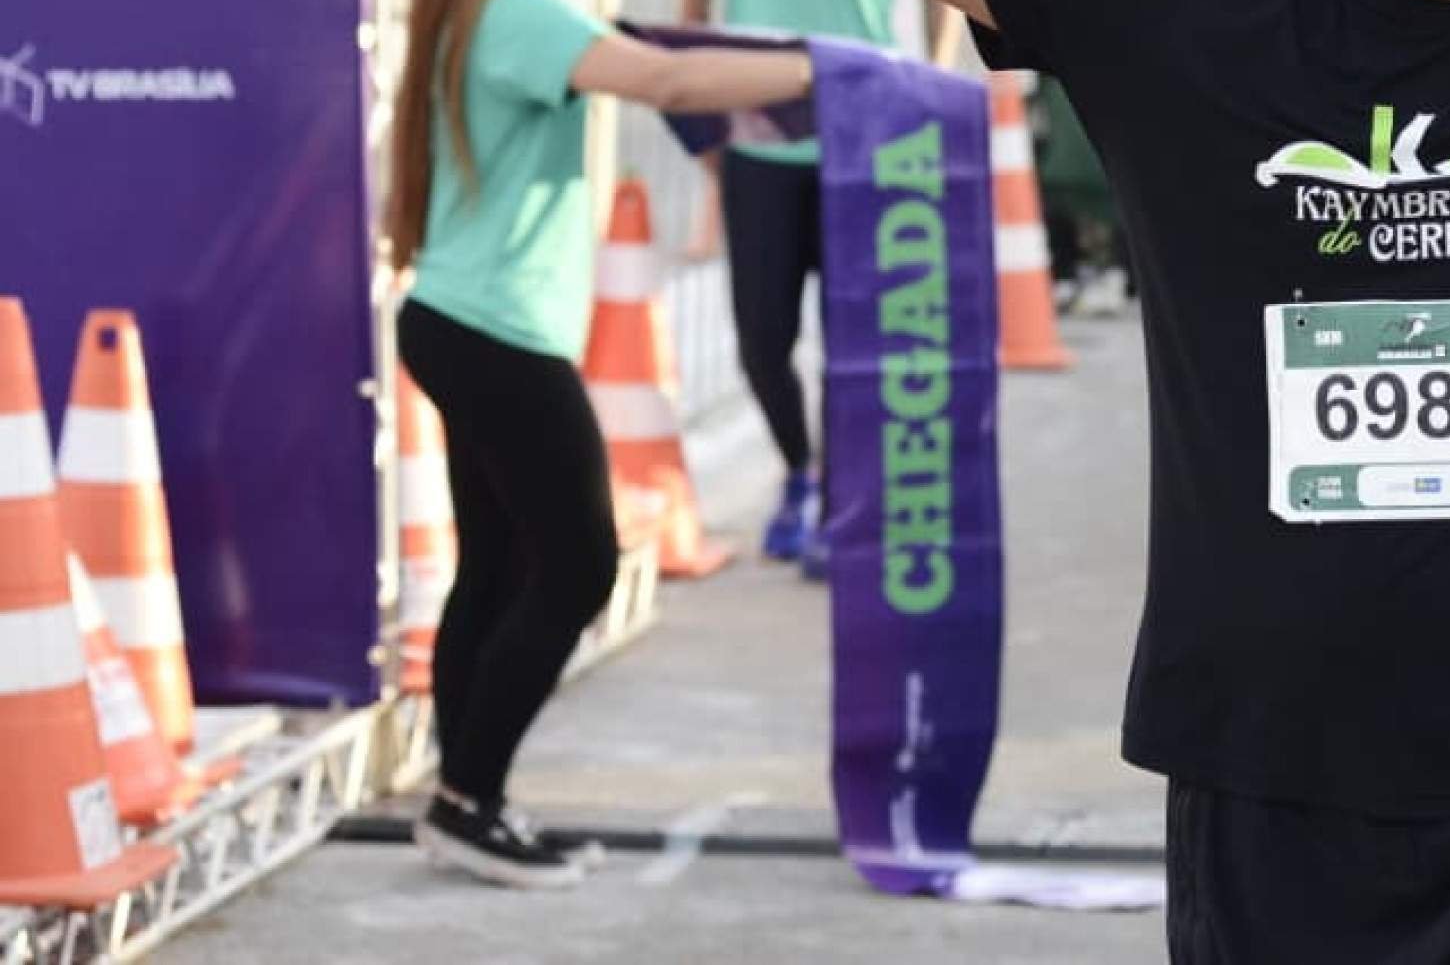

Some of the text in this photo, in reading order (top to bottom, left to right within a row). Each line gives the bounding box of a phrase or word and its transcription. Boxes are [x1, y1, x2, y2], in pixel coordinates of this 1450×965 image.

[46, 68, 91, 102] TV
[1317, 214, 1362, 254] do
[873, 121, 957, 615] CHEGADA
